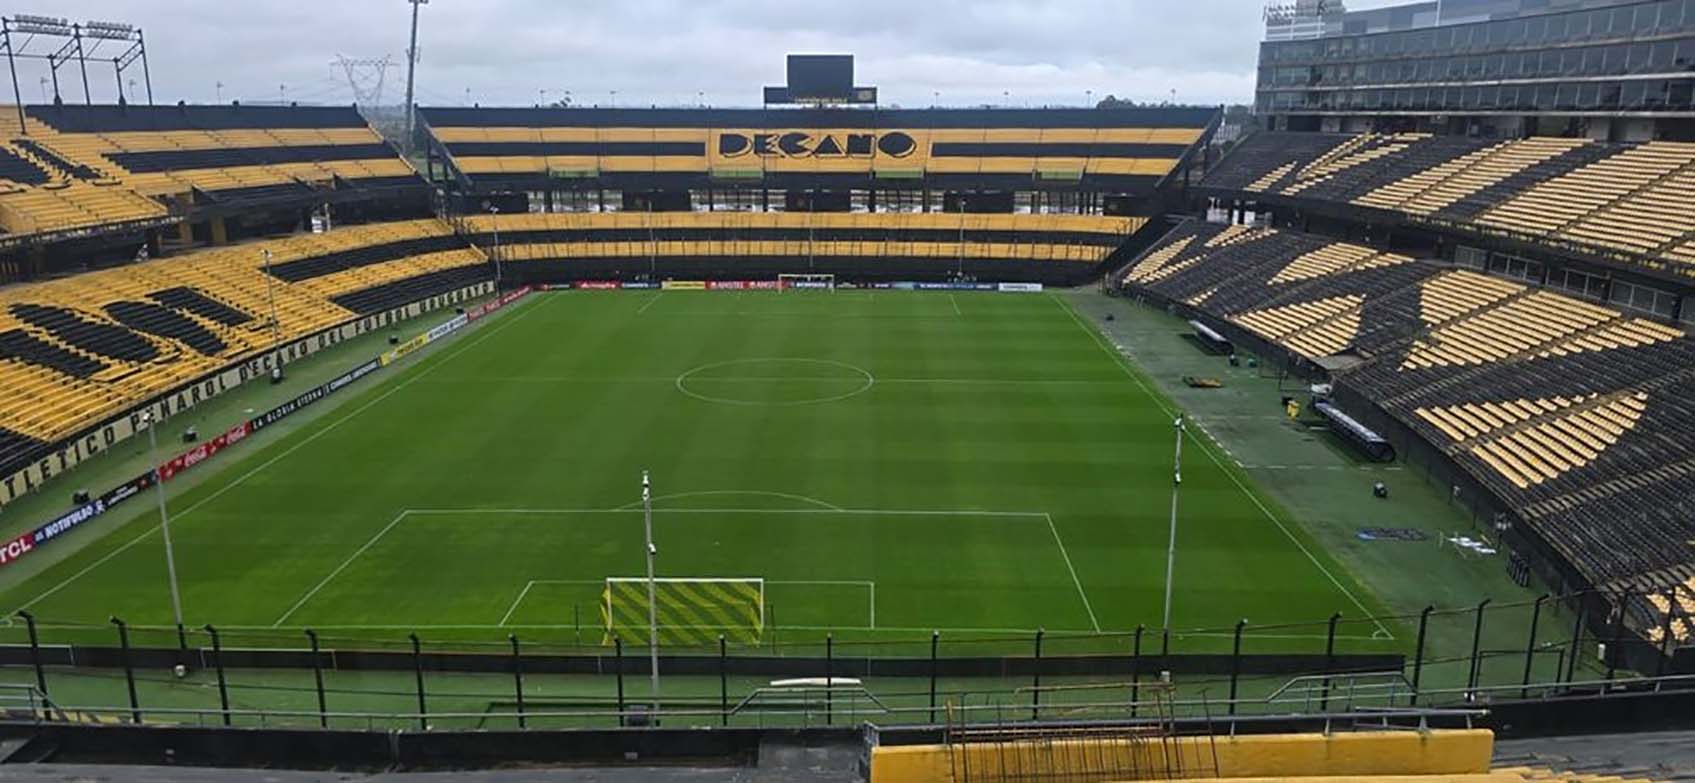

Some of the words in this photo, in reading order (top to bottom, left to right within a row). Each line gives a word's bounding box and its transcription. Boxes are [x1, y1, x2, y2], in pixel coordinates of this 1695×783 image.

[719, 131, 917, 158] DECANO
[0, 426, 114, 507] TLETICO
[239, 341, 308, 380] DECANO
[318, 328, 344, 348] DEL
[0, 538, 32, 563] TCL
